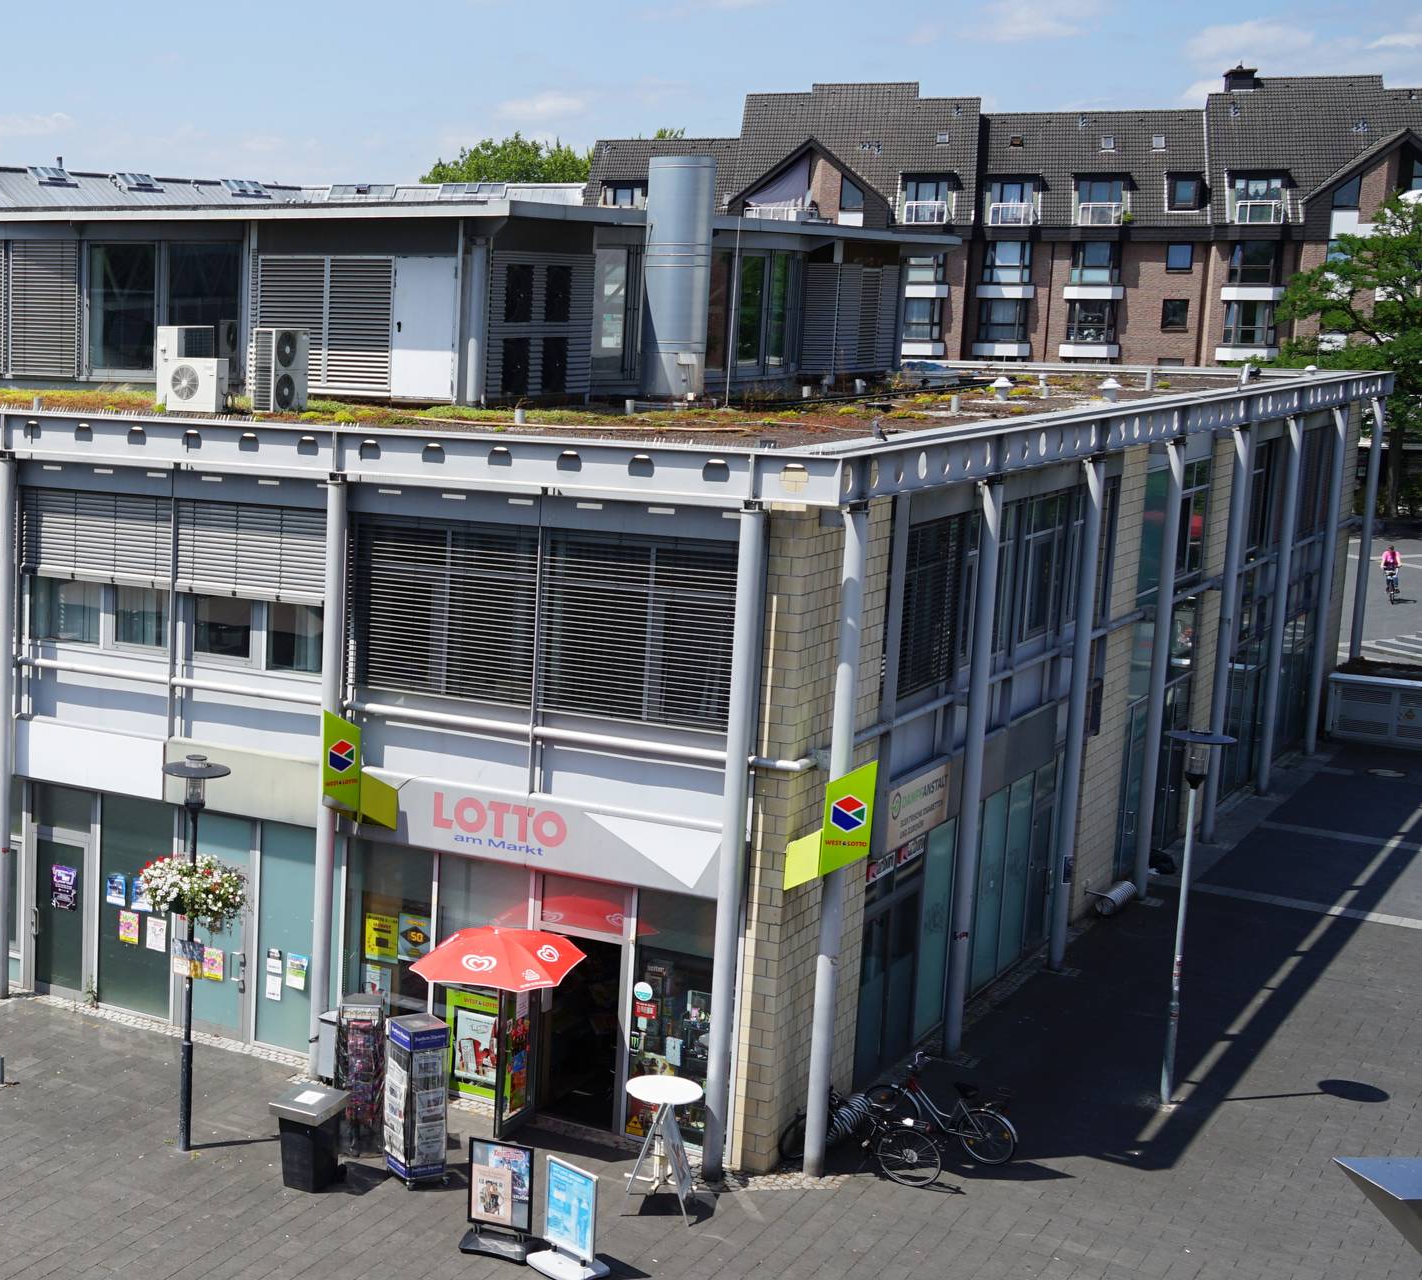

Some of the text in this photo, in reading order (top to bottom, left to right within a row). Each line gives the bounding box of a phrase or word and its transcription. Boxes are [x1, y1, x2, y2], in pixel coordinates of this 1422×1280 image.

[433, 791, 567, 848] LOTTO
[454, 834, 544, 856] am Markt
